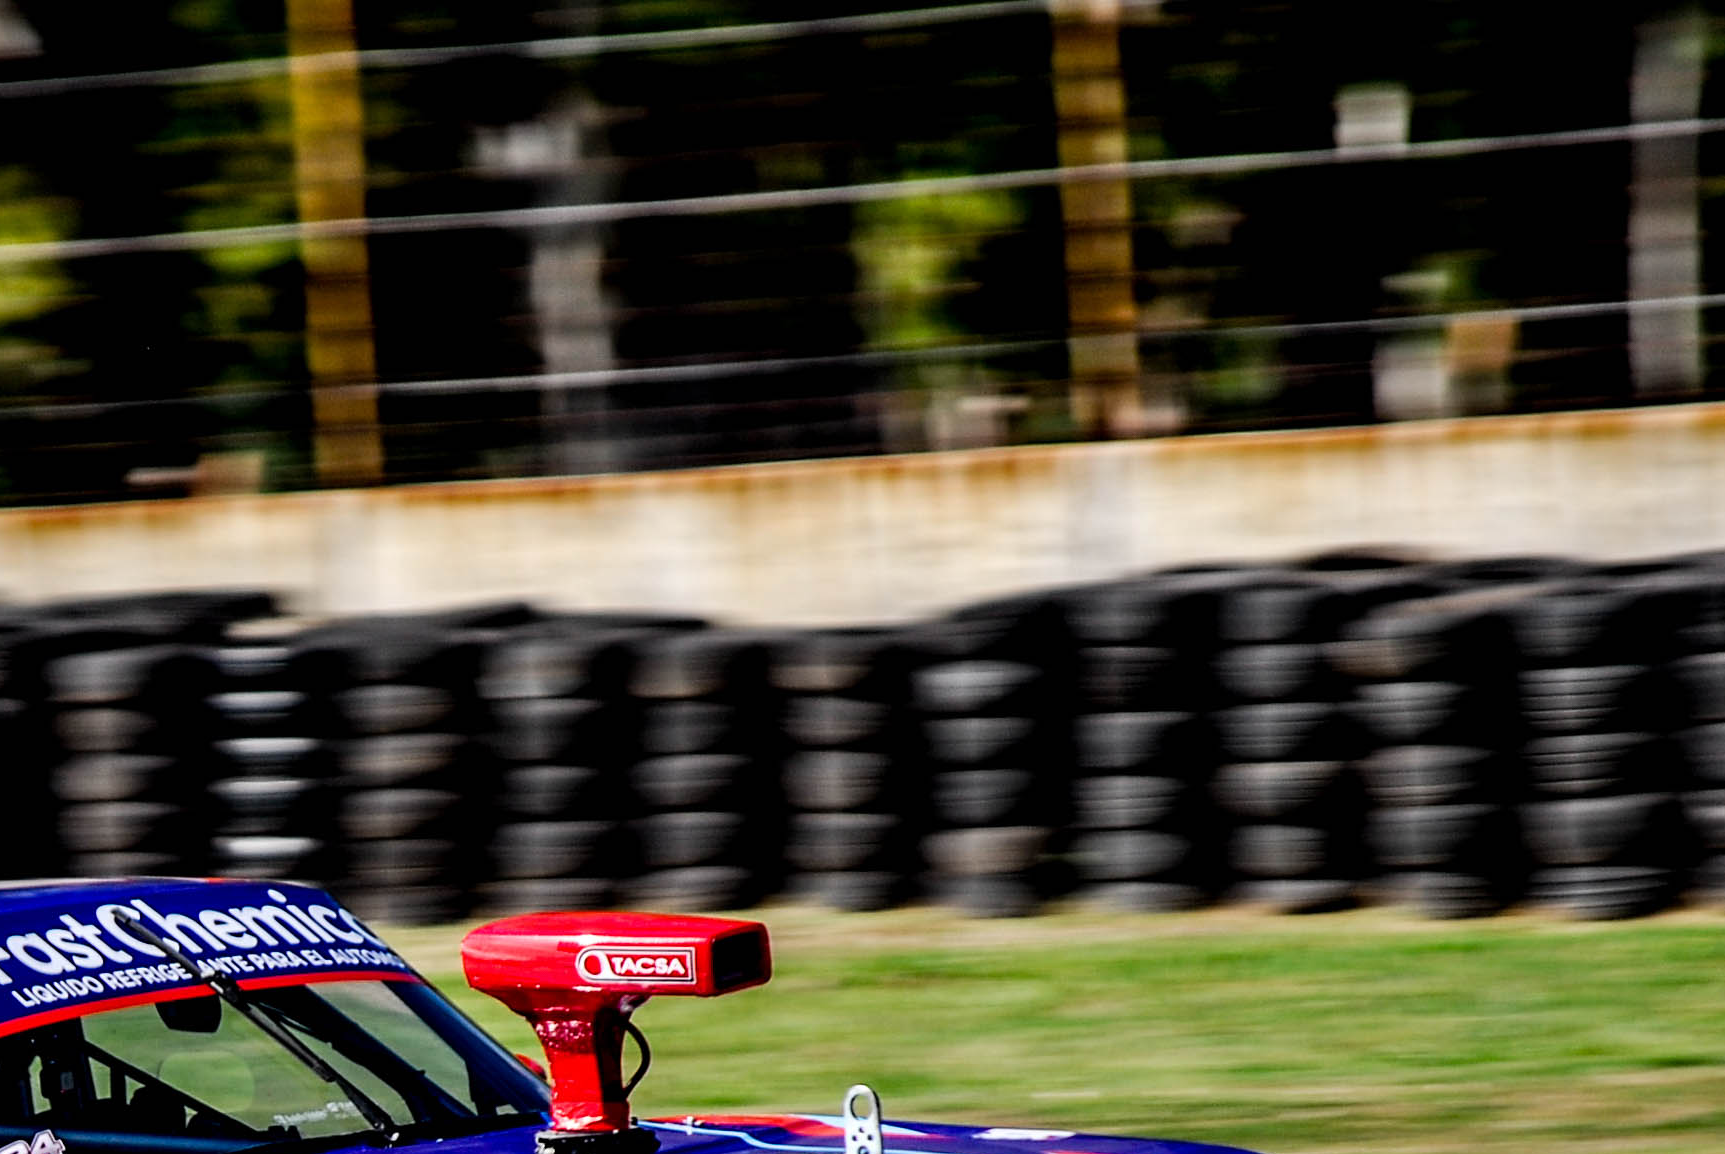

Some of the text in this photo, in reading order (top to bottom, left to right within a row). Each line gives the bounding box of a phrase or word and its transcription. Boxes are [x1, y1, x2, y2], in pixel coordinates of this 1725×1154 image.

[12, 976, 104, 1007] LIQUIDO
[99, 955, 253, 990] REFRIGEANTE
[250, 951, 308, 970] PARA
[300, 950, 333, 966] EL
[611, 957, 685, 975] TACSA
